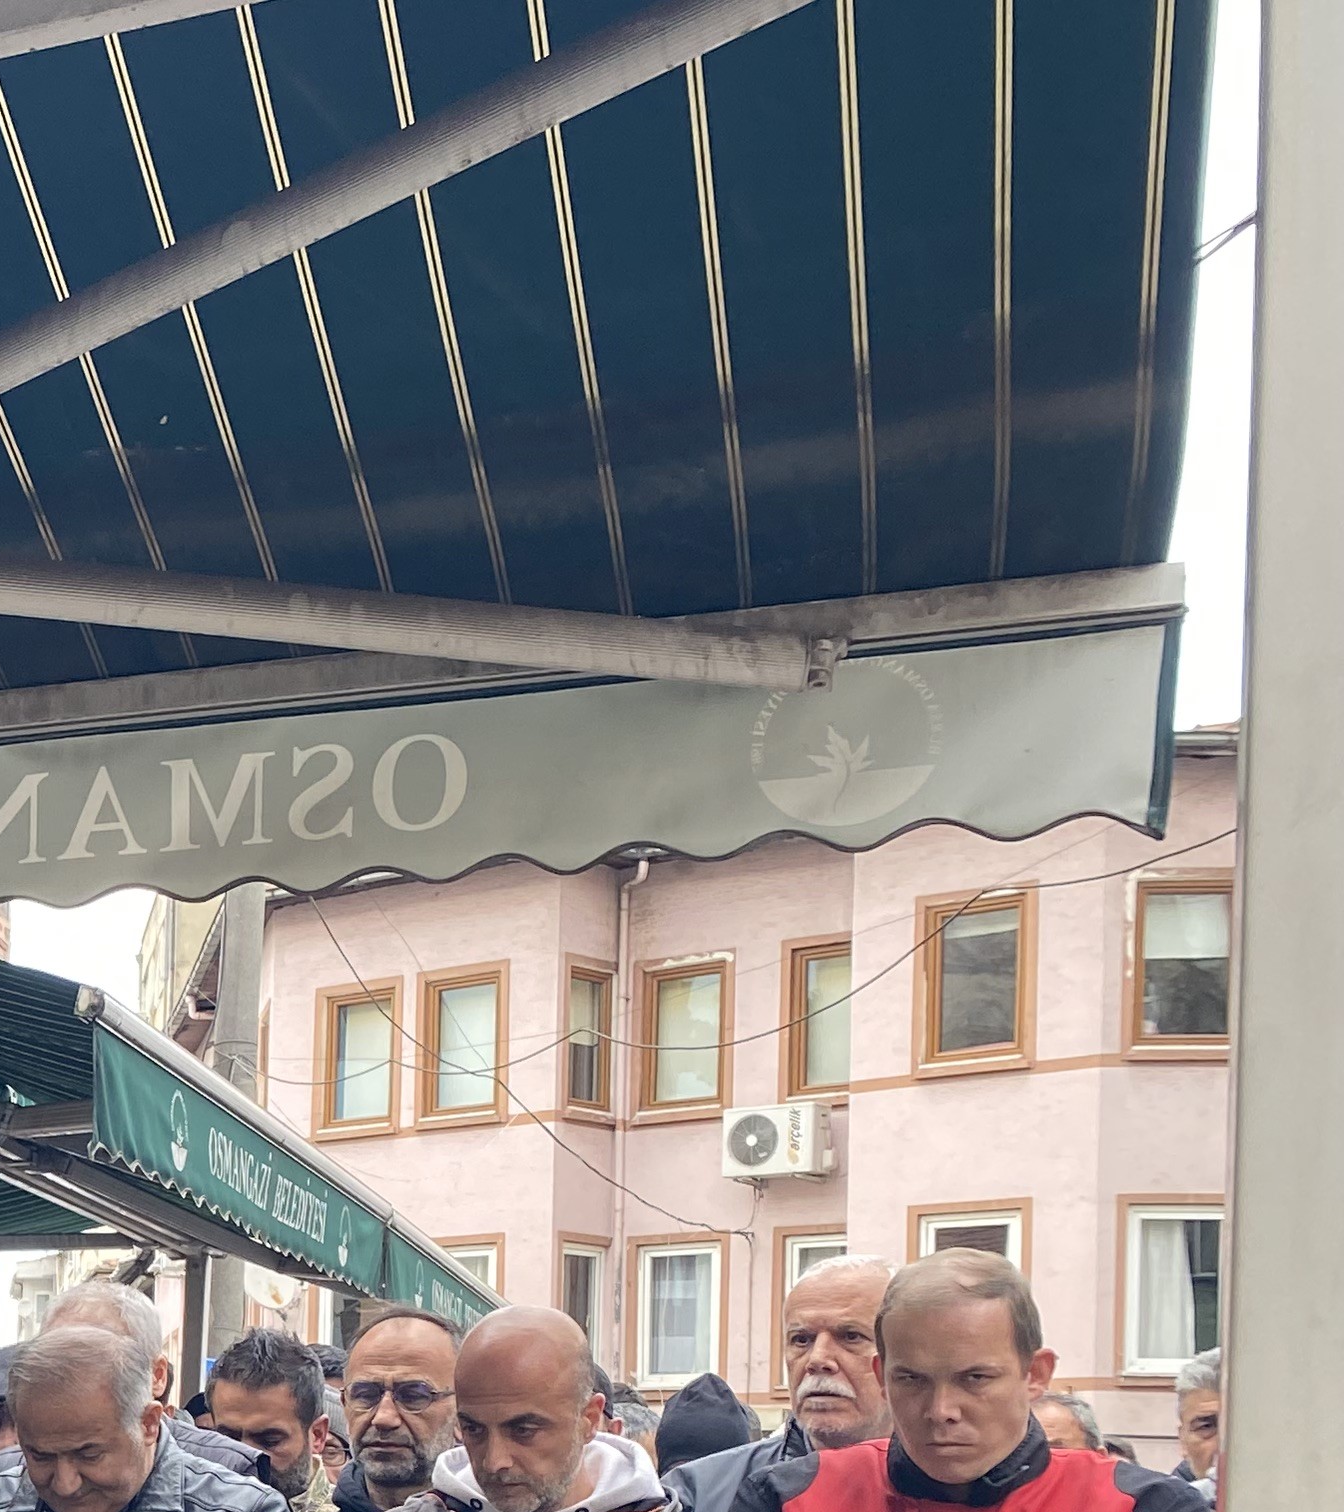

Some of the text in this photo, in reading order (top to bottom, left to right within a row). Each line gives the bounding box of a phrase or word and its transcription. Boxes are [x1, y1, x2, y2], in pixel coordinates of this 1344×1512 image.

[790, 1107, 803, 1151] arçelik
[208, 1127, 328, 1244] OSMANGAZİ BELEDİYESİ
